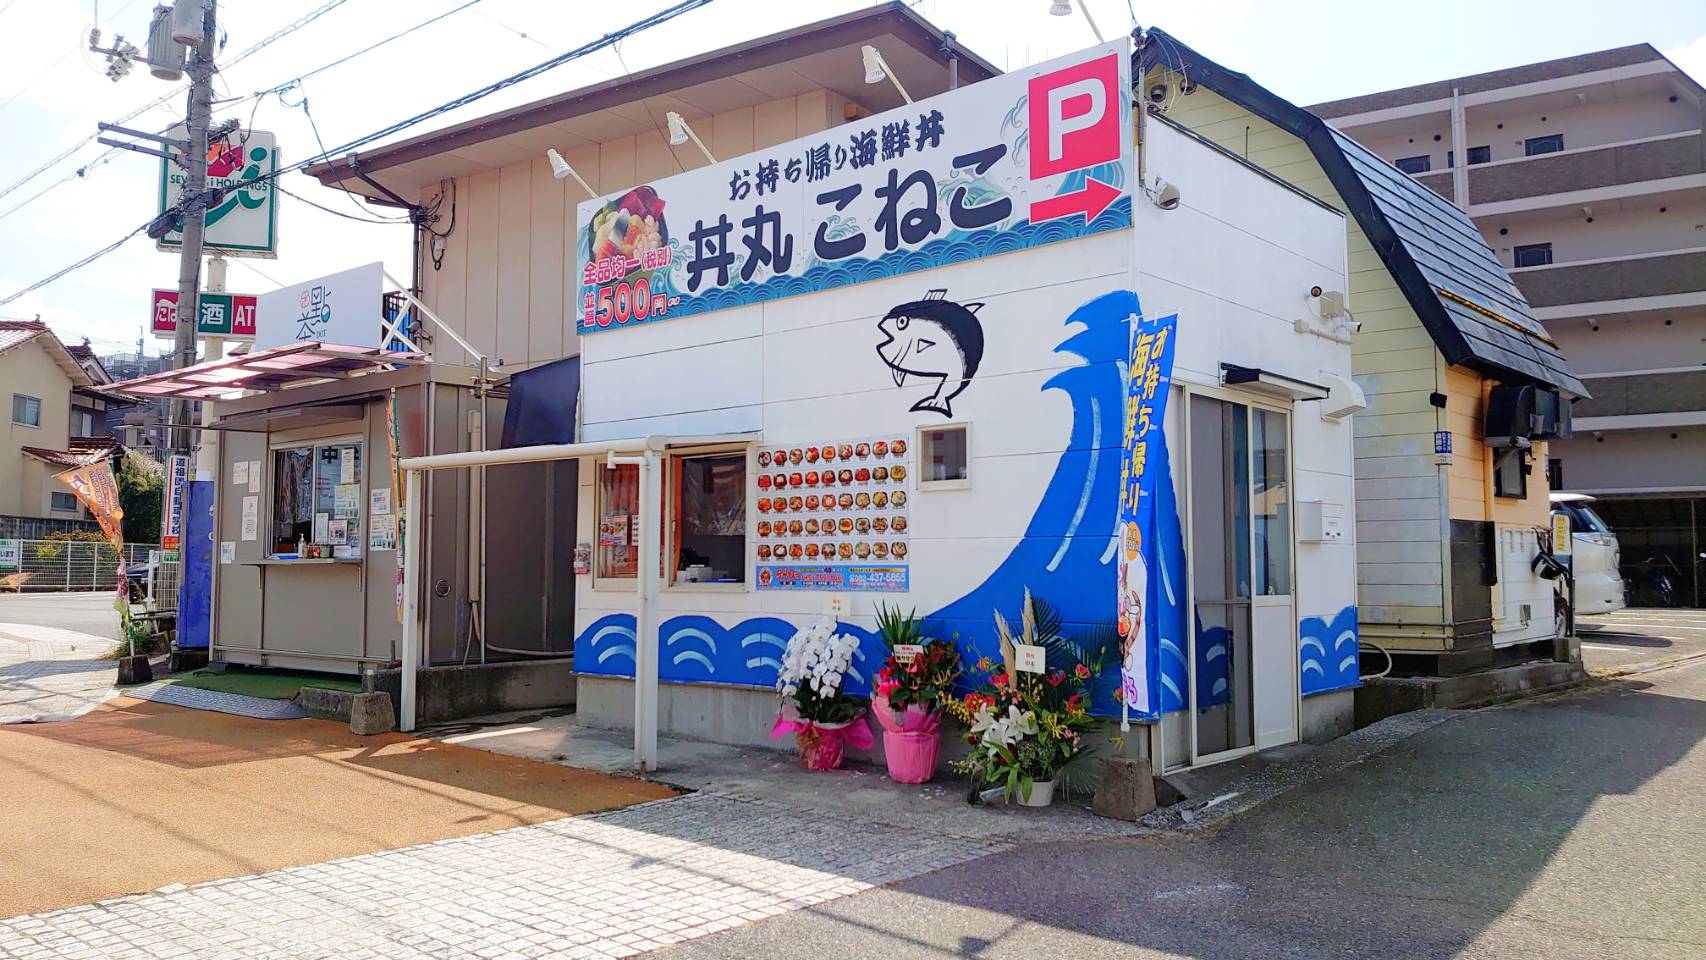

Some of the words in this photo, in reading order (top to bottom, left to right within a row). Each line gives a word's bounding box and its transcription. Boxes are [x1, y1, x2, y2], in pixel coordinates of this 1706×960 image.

[729, 109, 946, 201] お持ち帰り海鮮丼
[1048, 78, 1107, 162] P
[686, 204, 794, 293] 丼丸
[813, 143, 1014, 261] こねこ
[201, 302, 225, 325] 酒
[234, 305, 257, 327] AT
[1129, 326, 1169, 516] お持ち帰り
